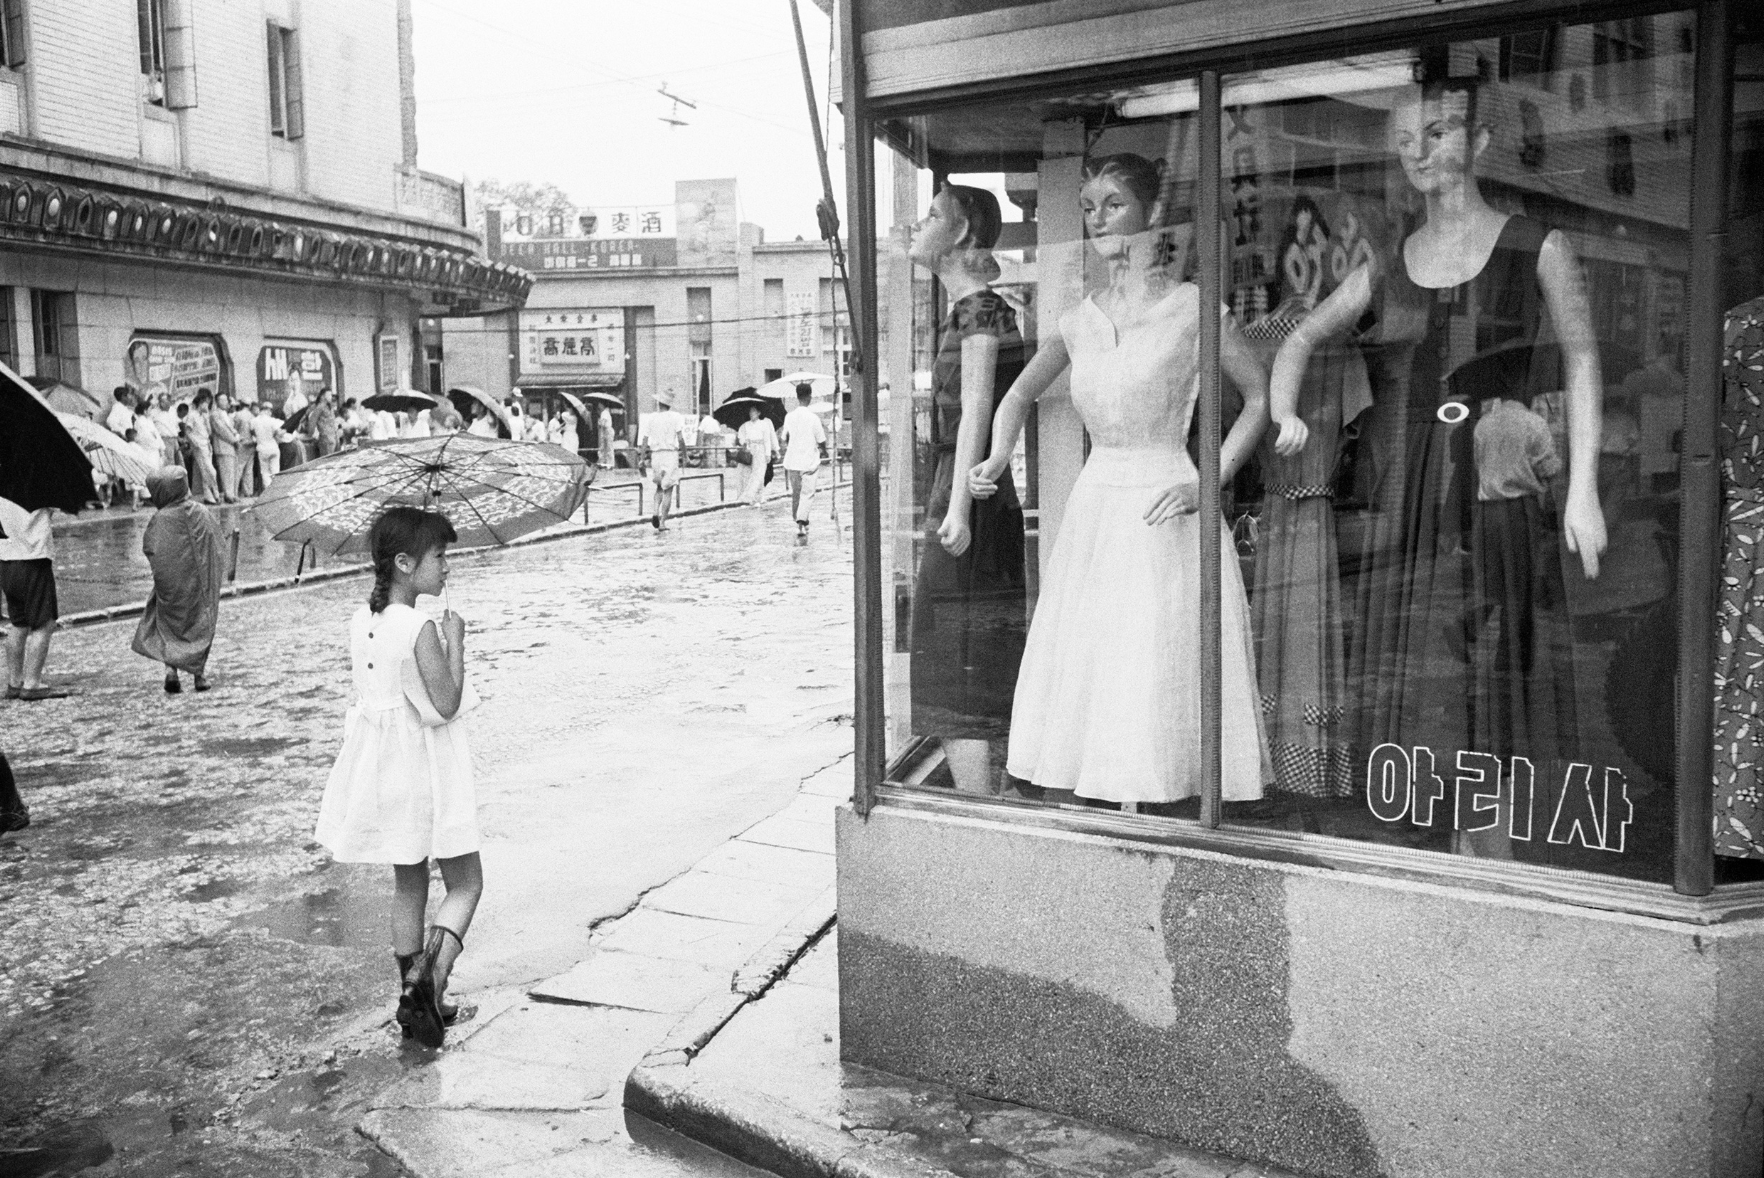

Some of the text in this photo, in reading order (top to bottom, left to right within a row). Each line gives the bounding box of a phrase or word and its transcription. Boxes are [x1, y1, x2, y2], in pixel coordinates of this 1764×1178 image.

[610, 211, 662, 235] 麥酒
[543, 242, 577, 255] HALL
[1366, 742, 1634, 853] 아리사
